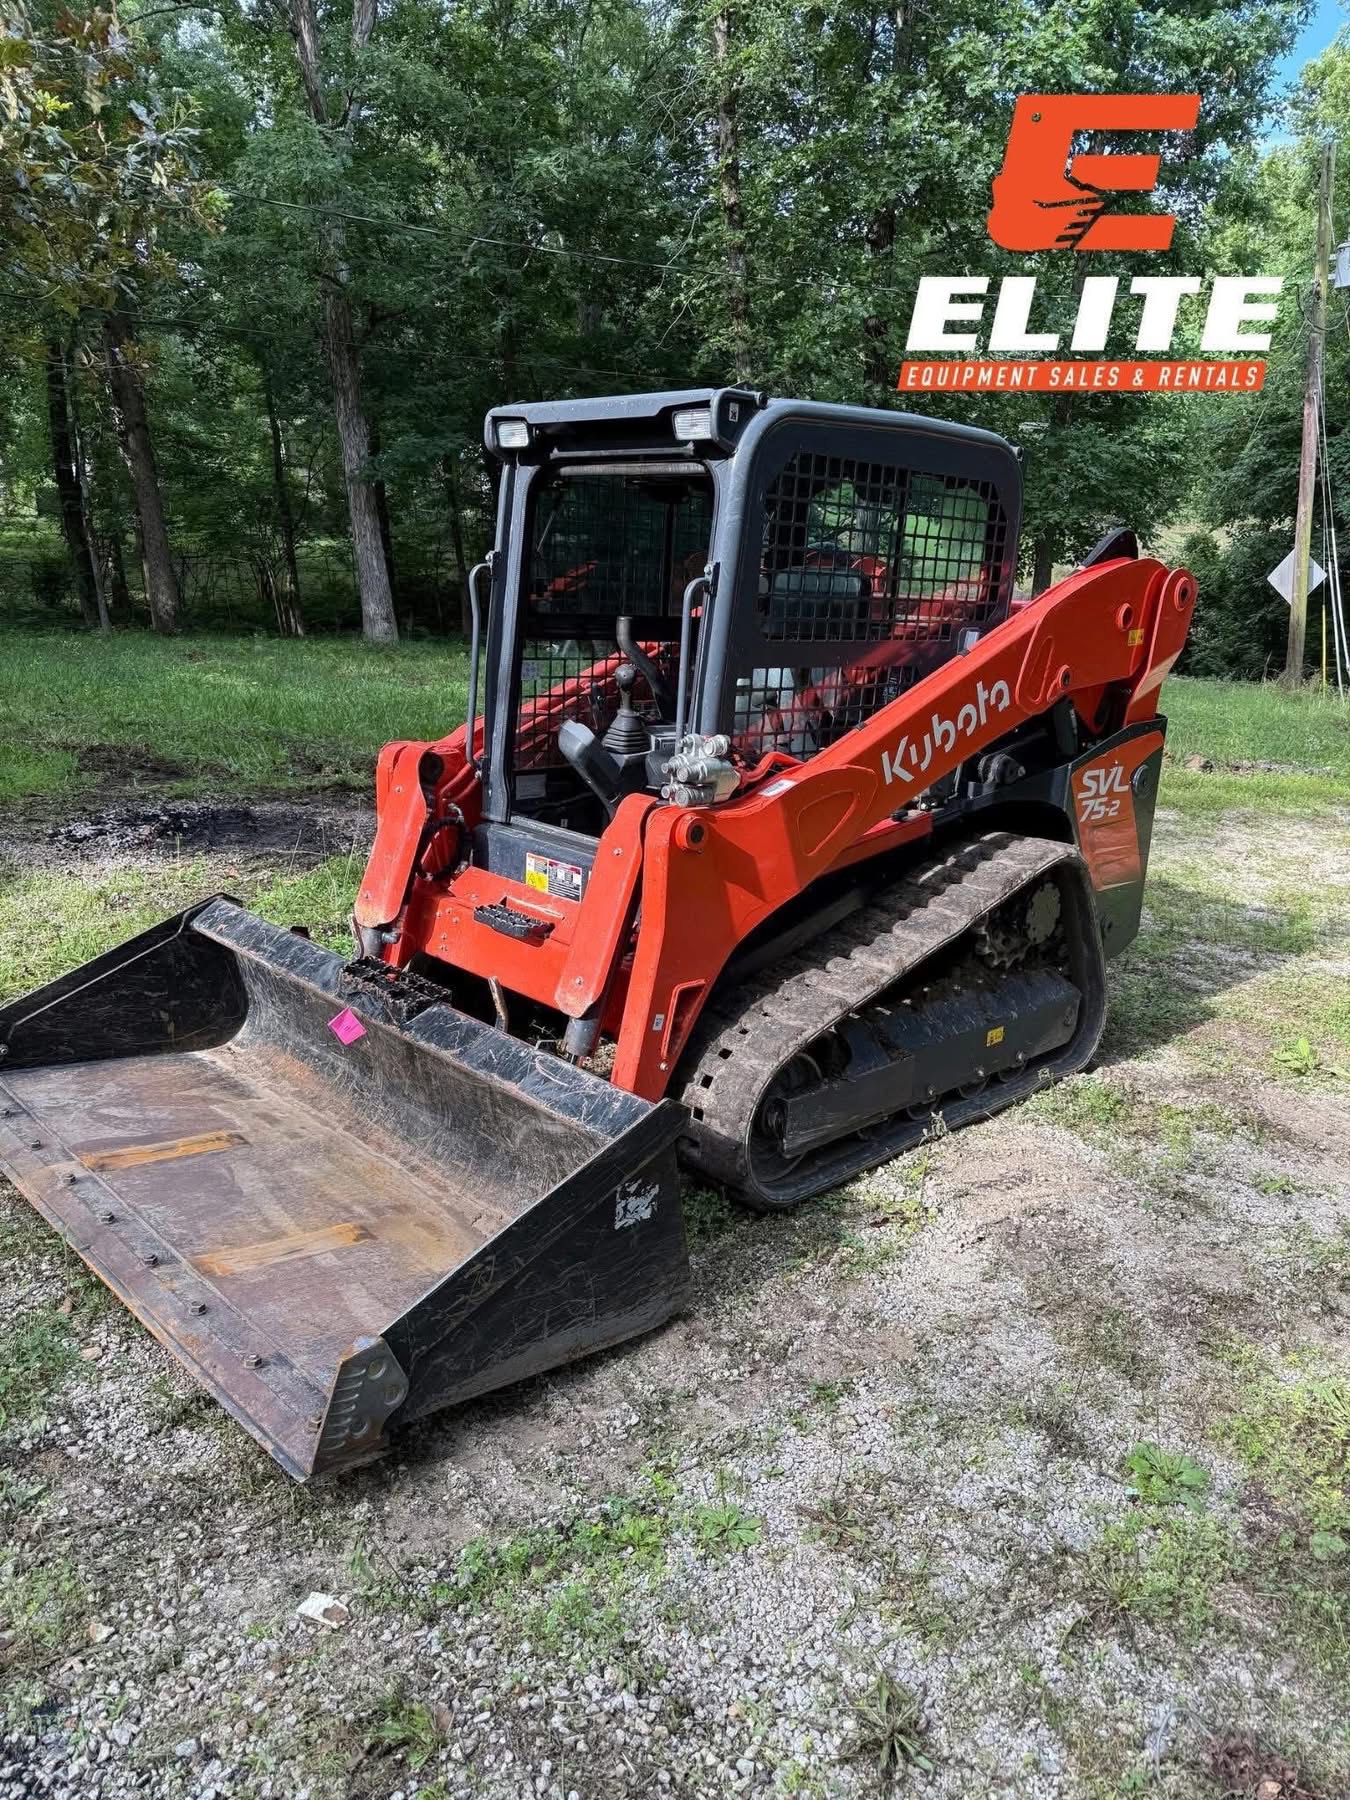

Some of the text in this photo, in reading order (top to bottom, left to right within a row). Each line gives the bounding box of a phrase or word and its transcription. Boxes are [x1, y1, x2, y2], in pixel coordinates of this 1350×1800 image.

[881, 680, 1010, 785] Kubota
[1077, 766, 1129, 799] SVL
[1080, 797, 1120, 822] 75-2
